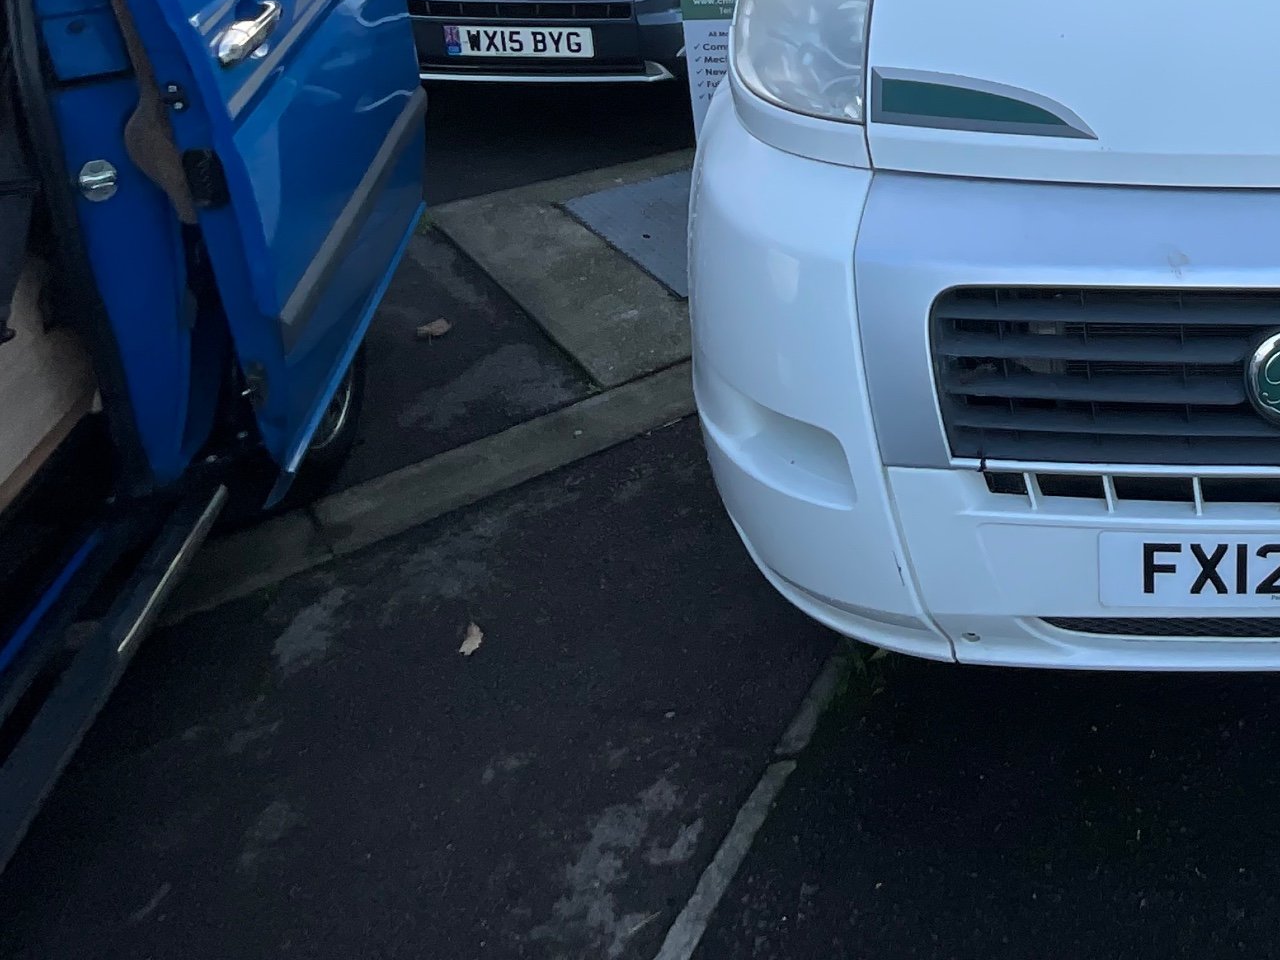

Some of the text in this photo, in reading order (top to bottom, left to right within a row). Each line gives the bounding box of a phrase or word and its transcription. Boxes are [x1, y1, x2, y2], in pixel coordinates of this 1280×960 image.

[466, 30, 582, 53] WX15 BYG
[702, 43, 729, 51] Com
